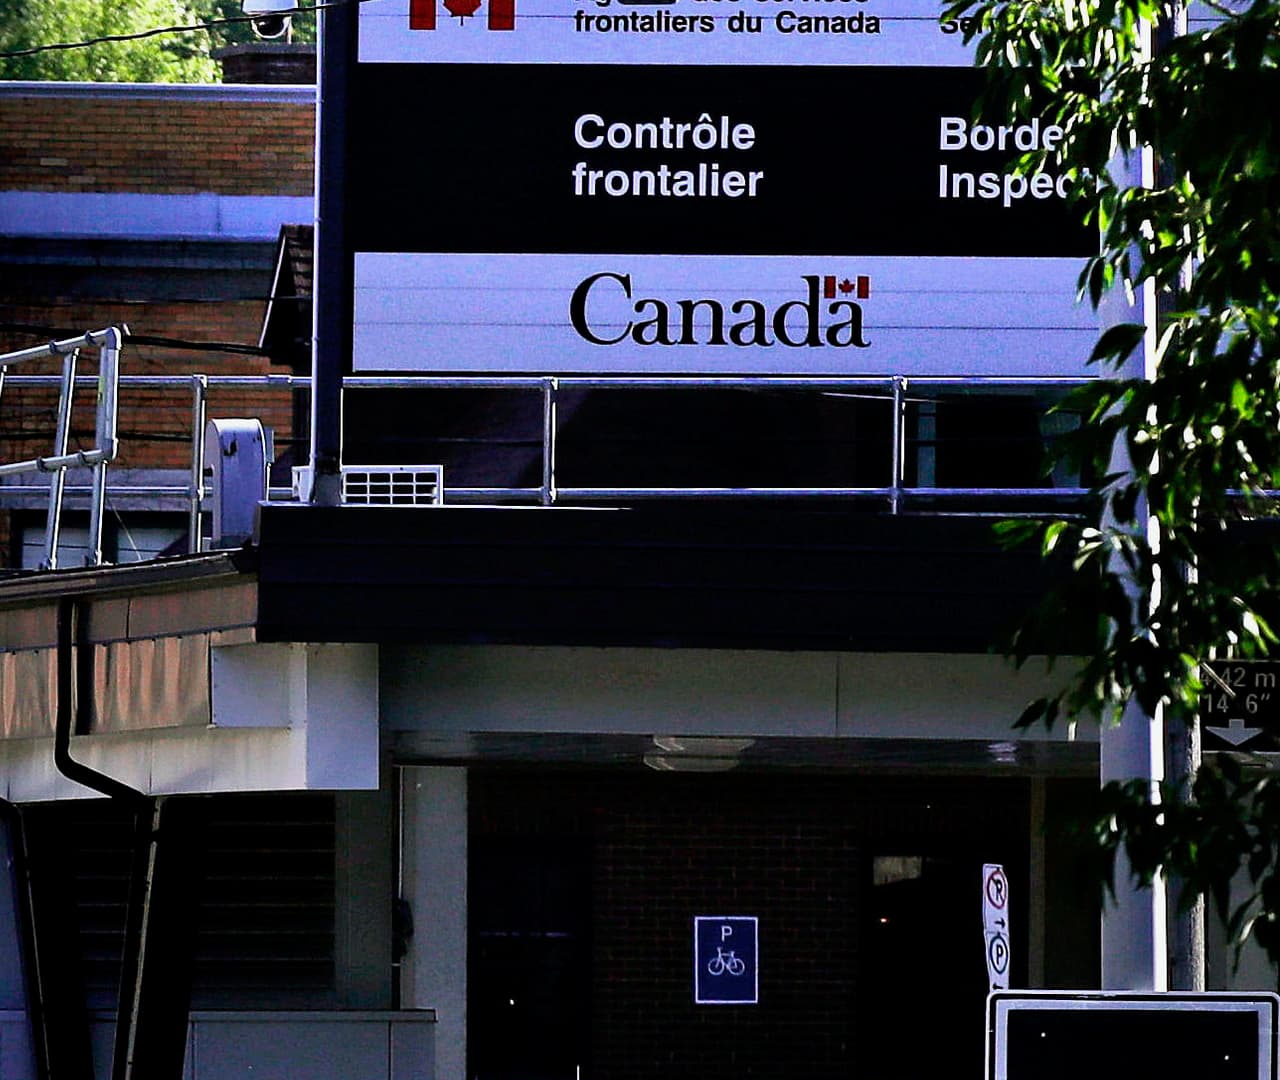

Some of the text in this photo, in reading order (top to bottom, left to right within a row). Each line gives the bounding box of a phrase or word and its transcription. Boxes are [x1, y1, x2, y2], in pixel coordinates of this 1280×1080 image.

[574, 10, 881, 33] frontaliers du Canada
[573, 112, 756, 151] Contrôle
[939, 116, 1065, 152] Borde
[572, 161, 764, 198] frontalier
[569, 272, 872, 349] Canada
[1254, 672, 1276, 688] m
[721, 926, 733, 941] P
